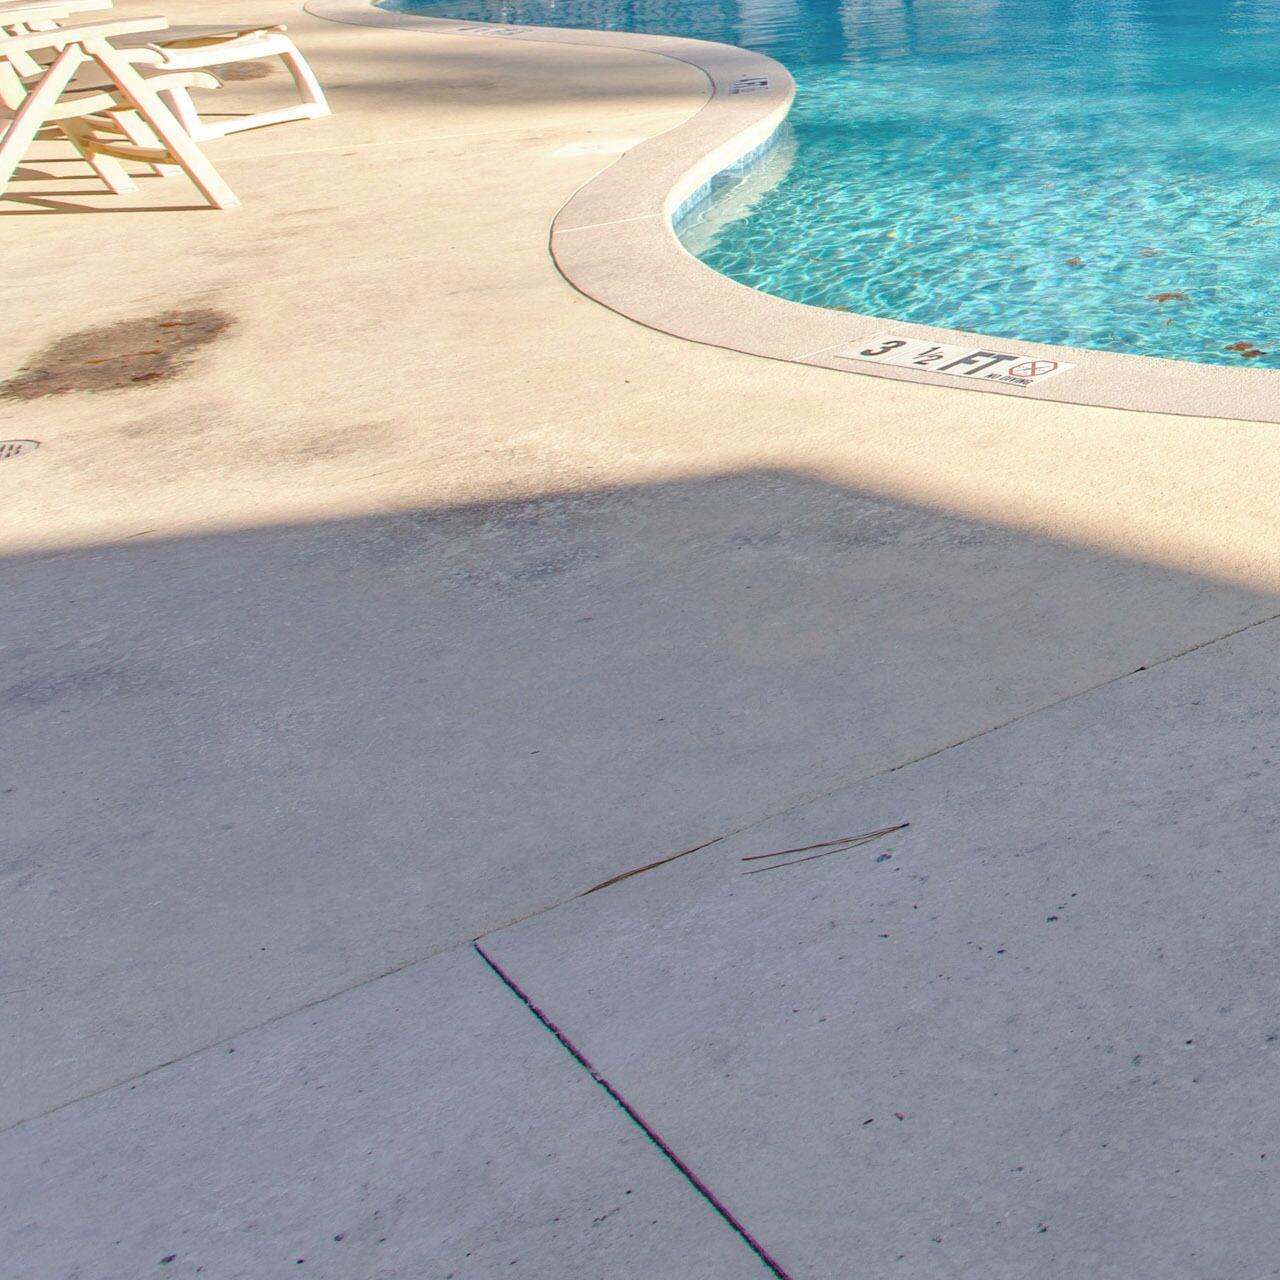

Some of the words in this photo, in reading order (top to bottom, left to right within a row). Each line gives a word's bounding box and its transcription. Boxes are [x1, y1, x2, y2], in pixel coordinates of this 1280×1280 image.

[860, 340, 906, 356] 3
[938, 351, 1020, 375] FT
[999, 376, 1034, 384] DIVING
